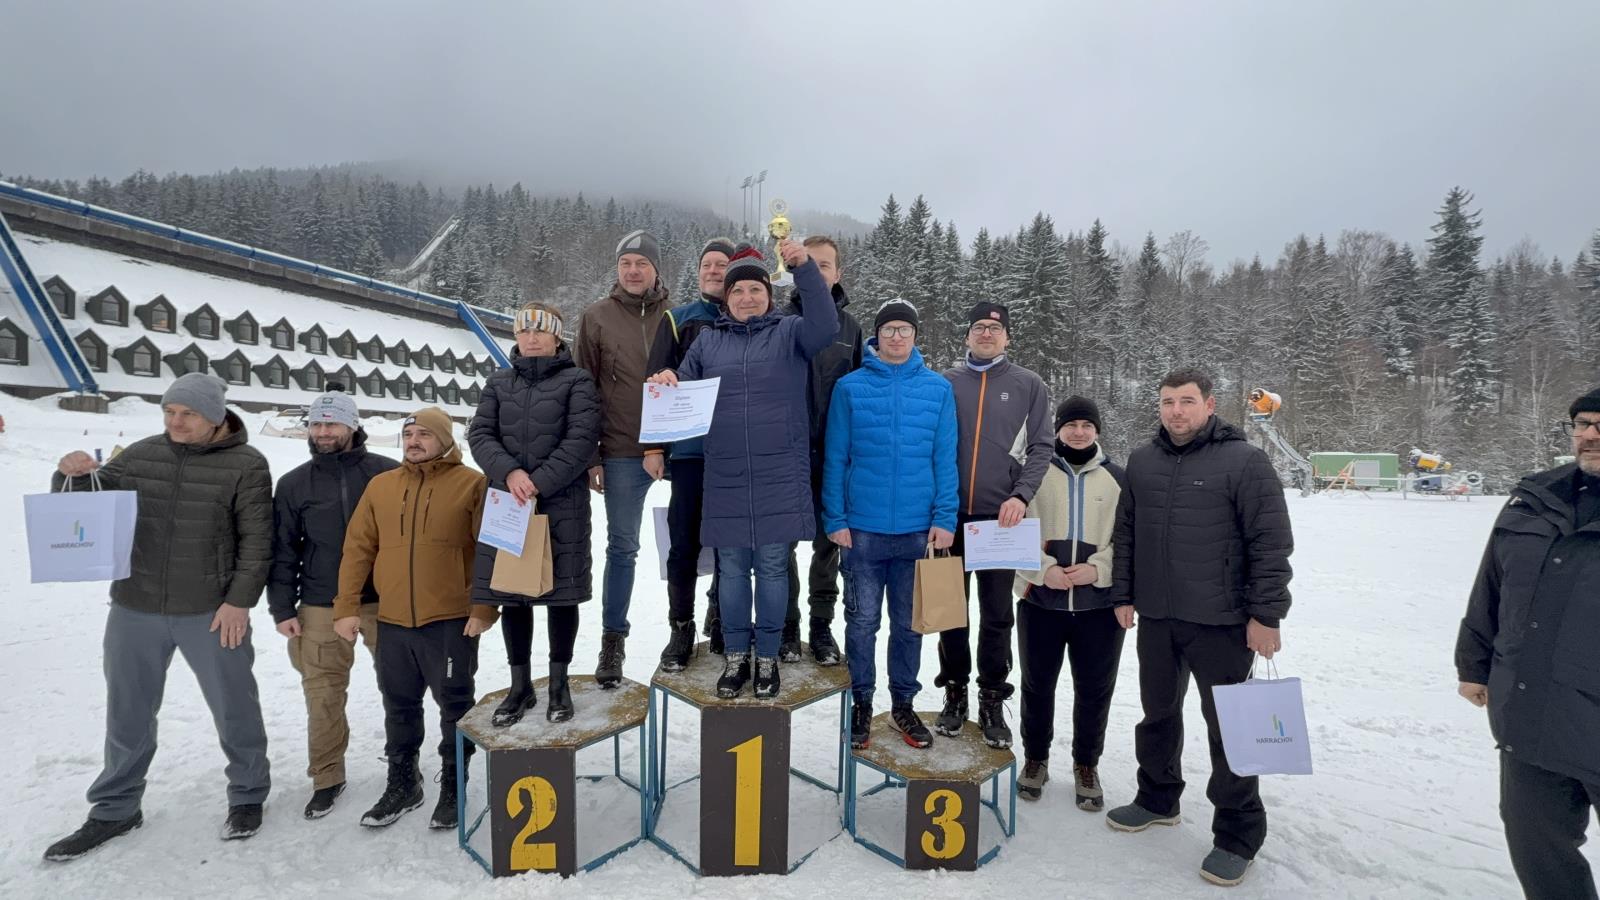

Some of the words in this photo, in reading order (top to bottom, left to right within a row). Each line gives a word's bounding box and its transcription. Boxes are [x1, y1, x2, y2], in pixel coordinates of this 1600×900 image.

[506, 776, 556, 869] 2
[727, 735, 762, 866] 1
[921, 789, 965, 858] 3
